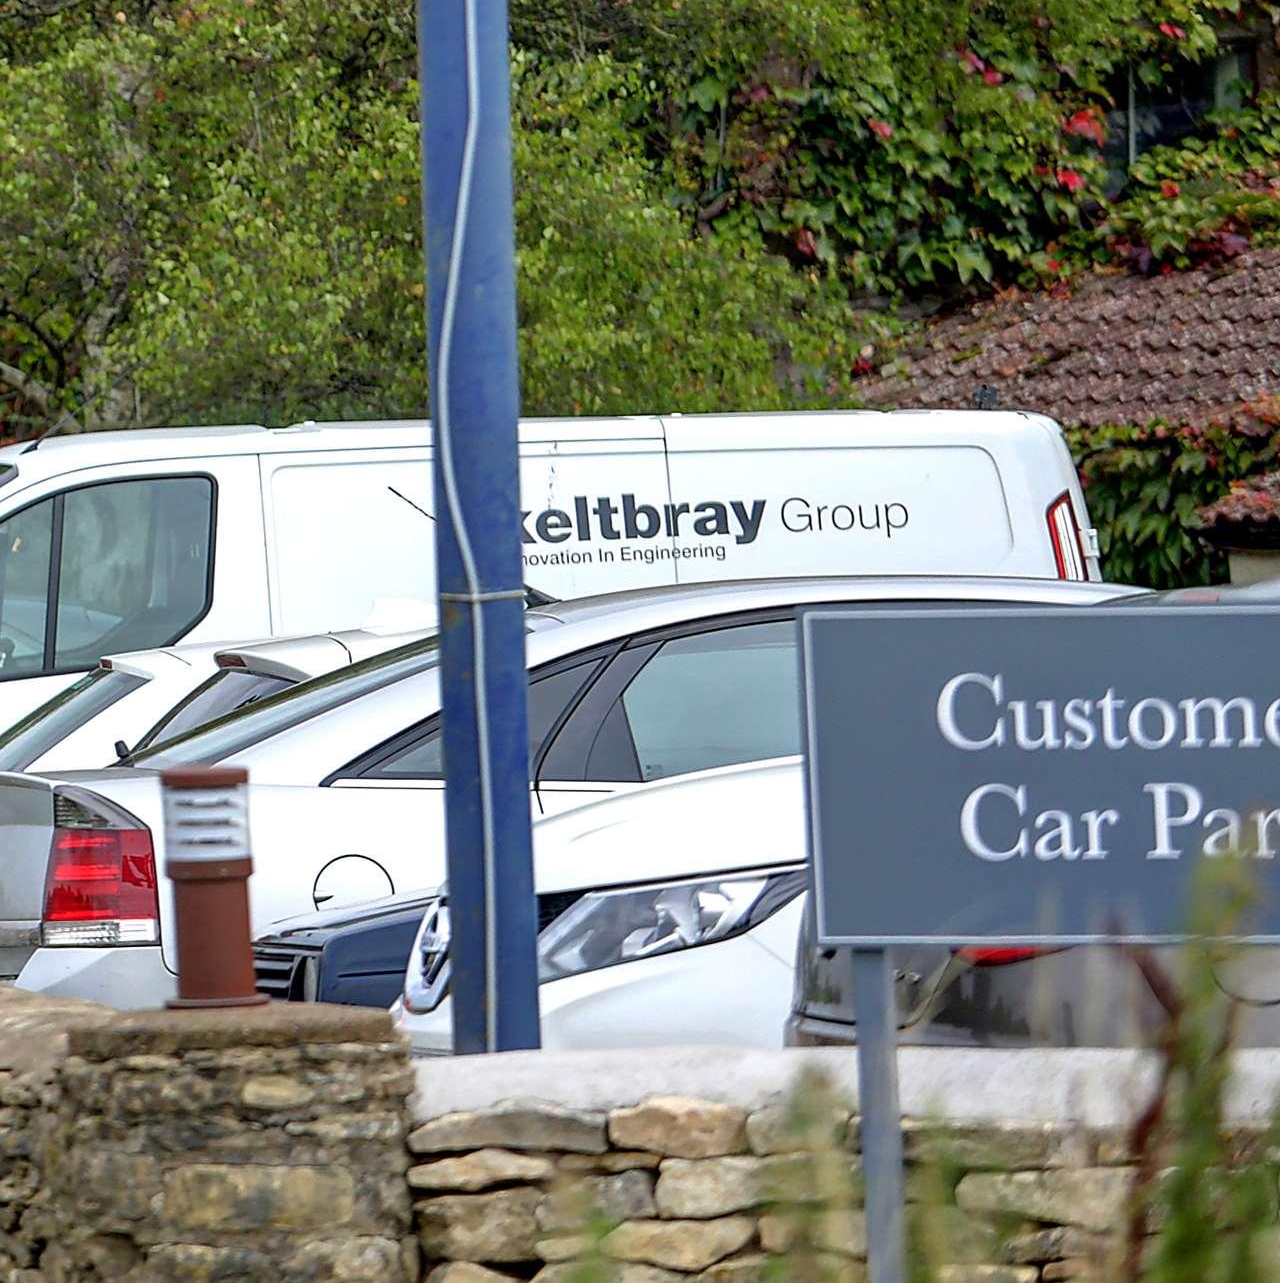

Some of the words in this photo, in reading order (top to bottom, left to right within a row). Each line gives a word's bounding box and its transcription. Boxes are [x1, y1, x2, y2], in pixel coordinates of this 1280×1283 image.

[779, 496, 910, 540] Group
[597, 547, 615, 564] In
[619, 545, 727, 565] Engineering
[960, 782, 1120, 860] Car
